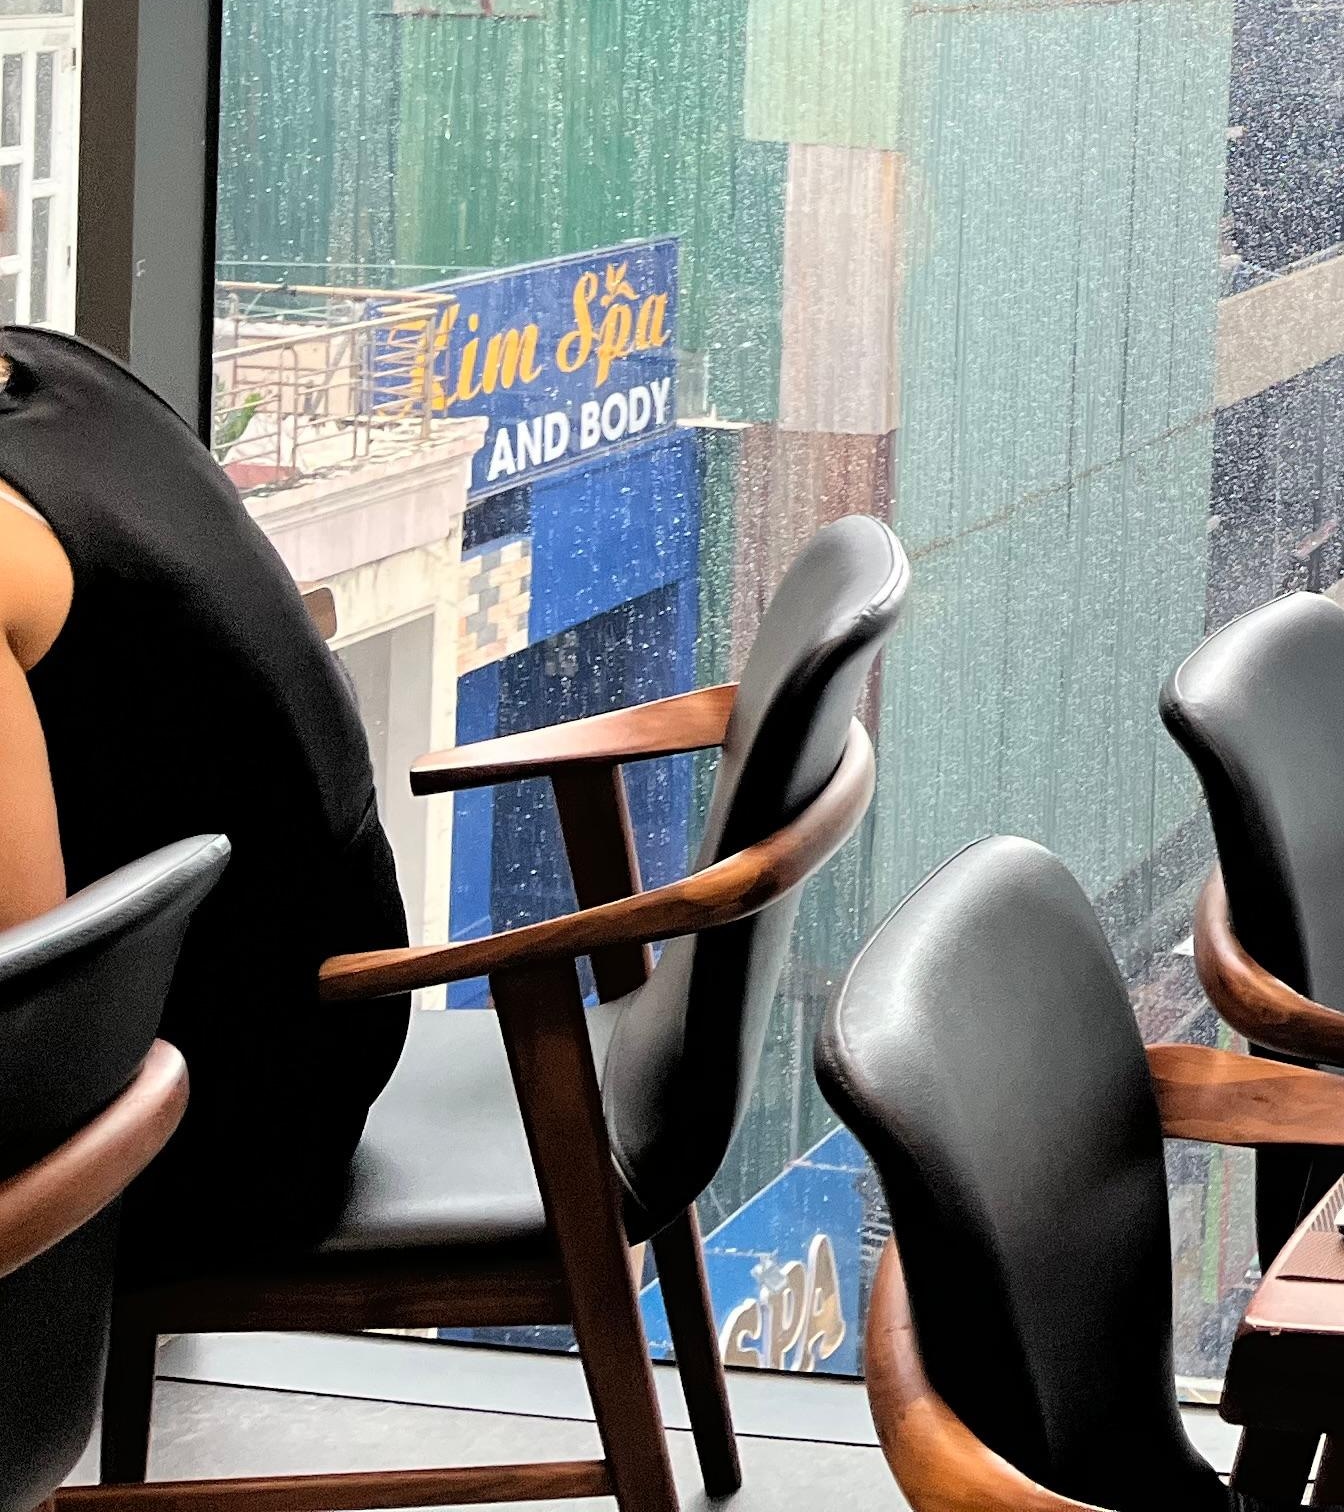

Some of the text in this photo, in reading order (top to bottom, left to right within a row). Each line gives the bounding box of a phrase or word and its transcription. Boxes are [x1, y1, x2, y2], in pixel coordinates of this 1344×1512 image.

[555, 271, 672, 387] Spa
[486, 376, 672, 482] AND BODY
